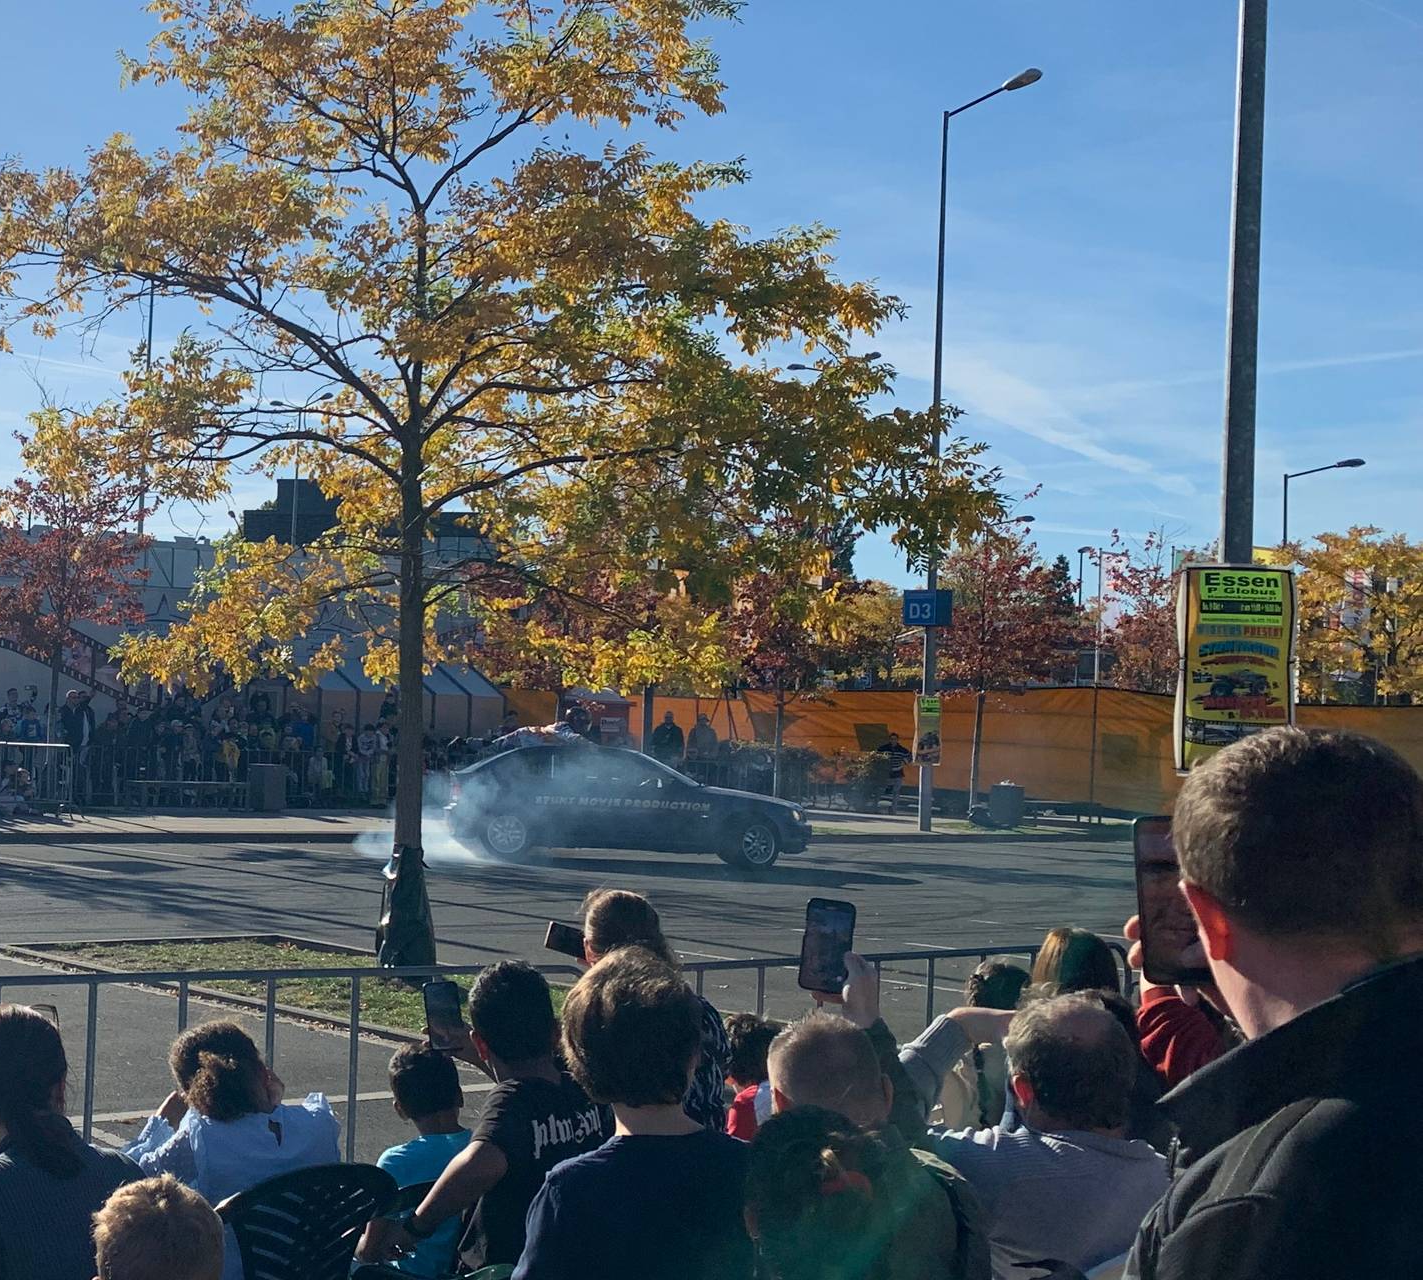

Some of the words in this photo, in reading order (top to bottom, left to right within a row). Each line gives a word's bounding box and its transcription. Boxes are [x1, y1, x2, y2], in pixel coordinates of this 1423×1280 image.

[1205, 573, 1279, 588] Essen
[1223, 587, 1277, 596] Globus
[909, 603, 931, 619] D3
[535, 796, 576, 806] STUNT
[578, 797, 622, 808] MOVIE
[624, 798, 711, 811] PRODUCTION
